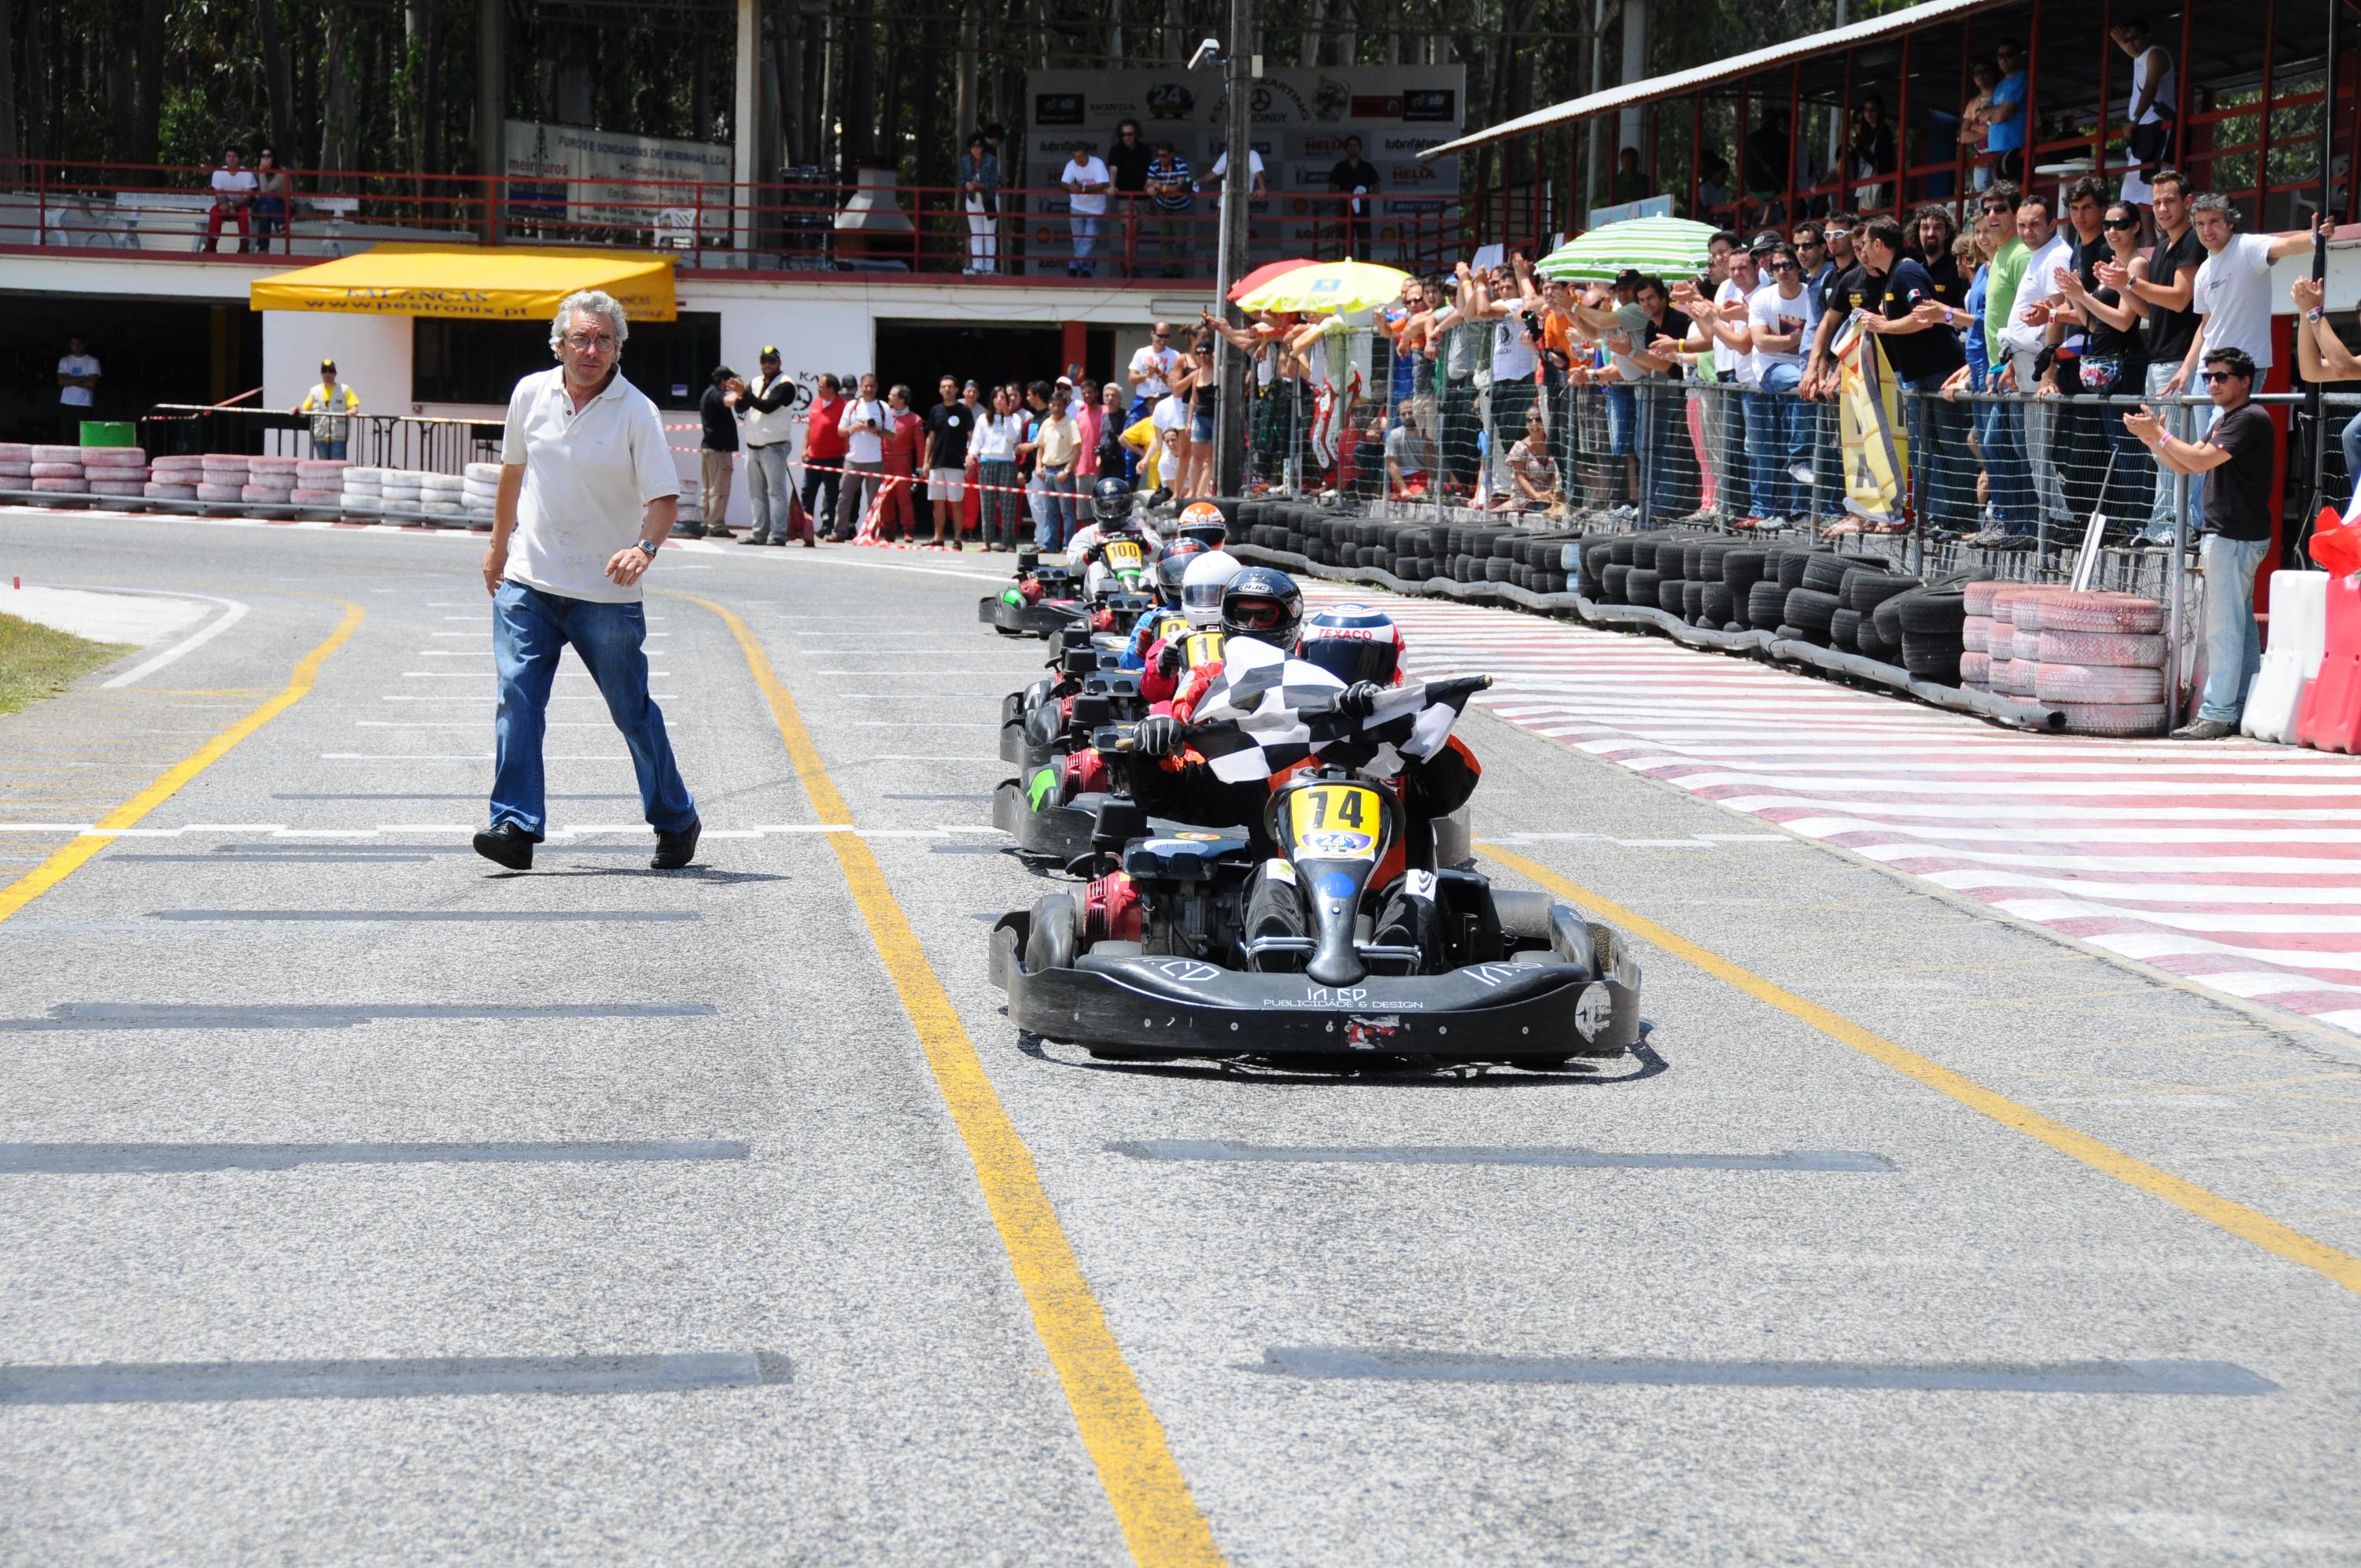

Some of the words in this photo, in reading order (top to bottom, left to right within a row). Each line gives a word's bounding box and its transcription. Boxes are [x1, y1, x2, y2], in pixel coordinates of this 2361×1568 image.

[1090, 103, 1136, 112] HONDA
[1393, 168, 1435, 179] HELIX
[1110, 544, 1138, 557] 100
[1319, 629, 1373, 640] TEXACO
[1308, 790, 1363, 828] 74
[1264, 999, 1354, 1008] PUBLICIDADE
